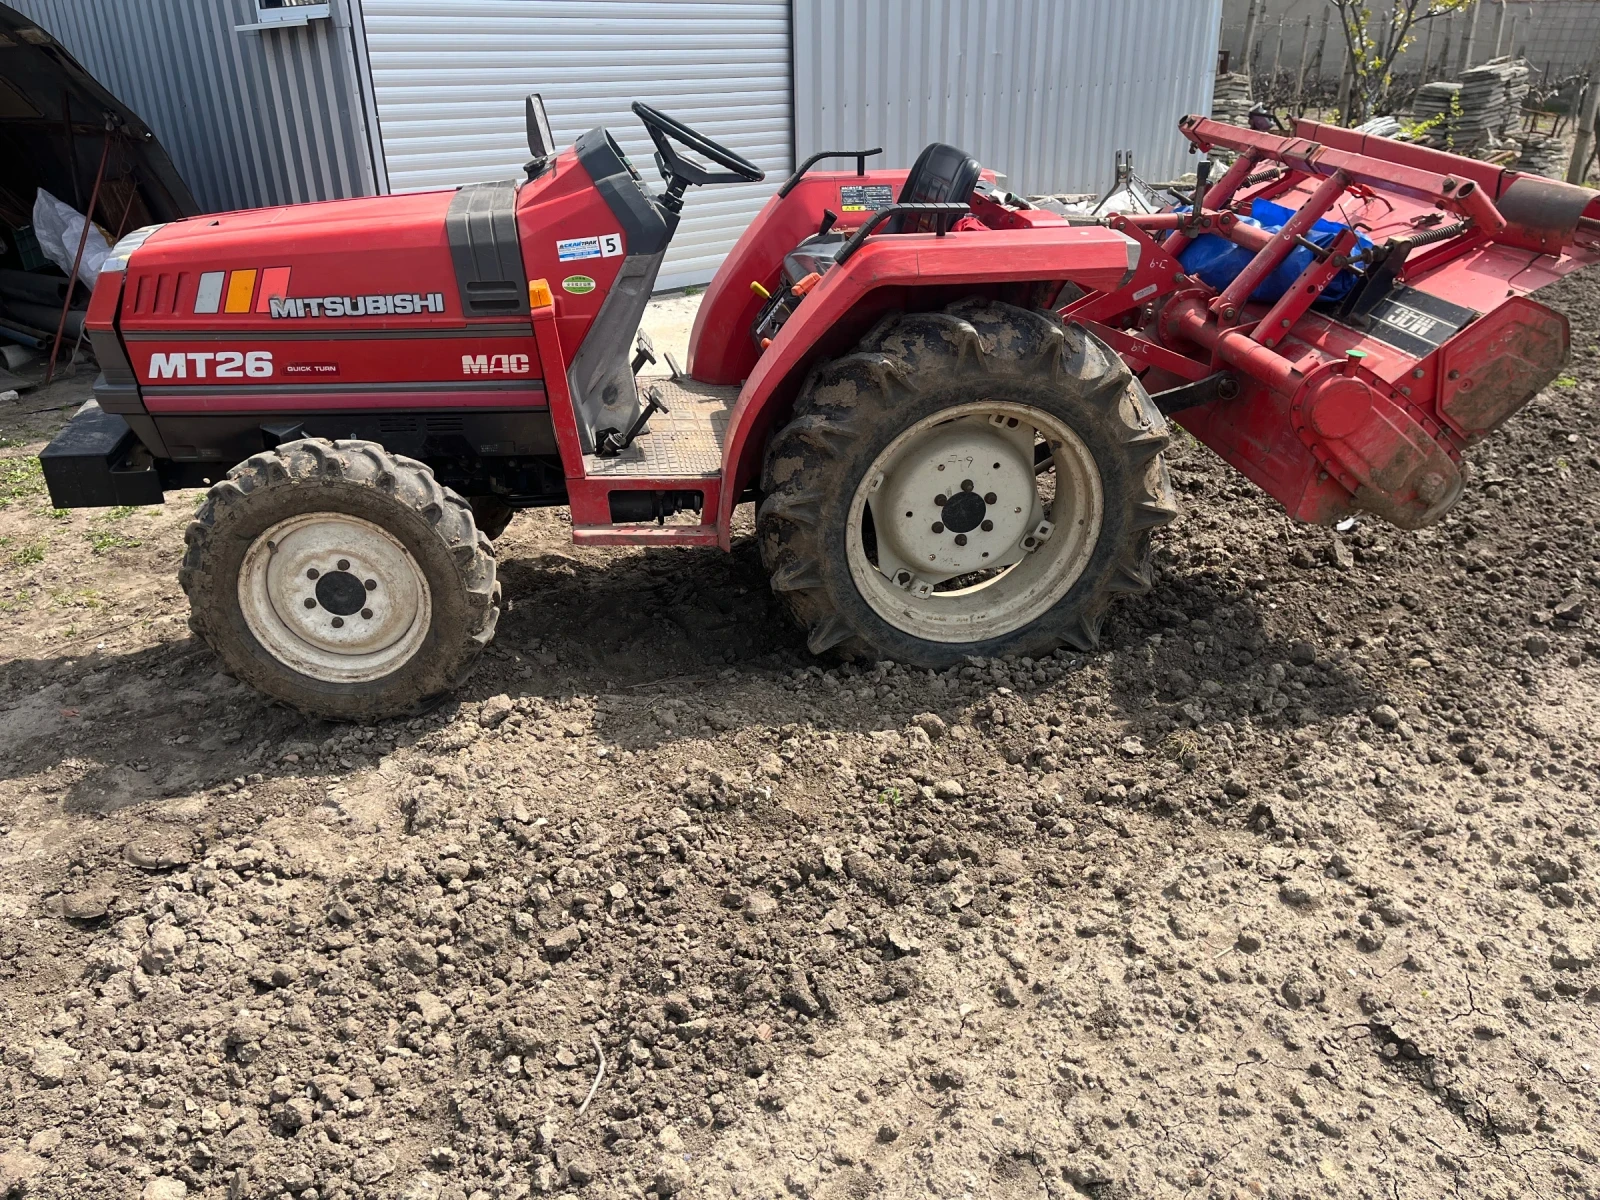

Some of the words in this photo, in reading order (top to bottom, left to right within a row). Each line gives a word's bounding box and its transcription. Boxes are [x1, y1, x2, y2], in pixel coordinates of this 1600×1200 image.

[605, 237, 617, 253] 5
[269, 293, 445, 318] MITSUBISHI
[148, 351, 274, 379] MT26
[461, 354, 530, 374] MAC
